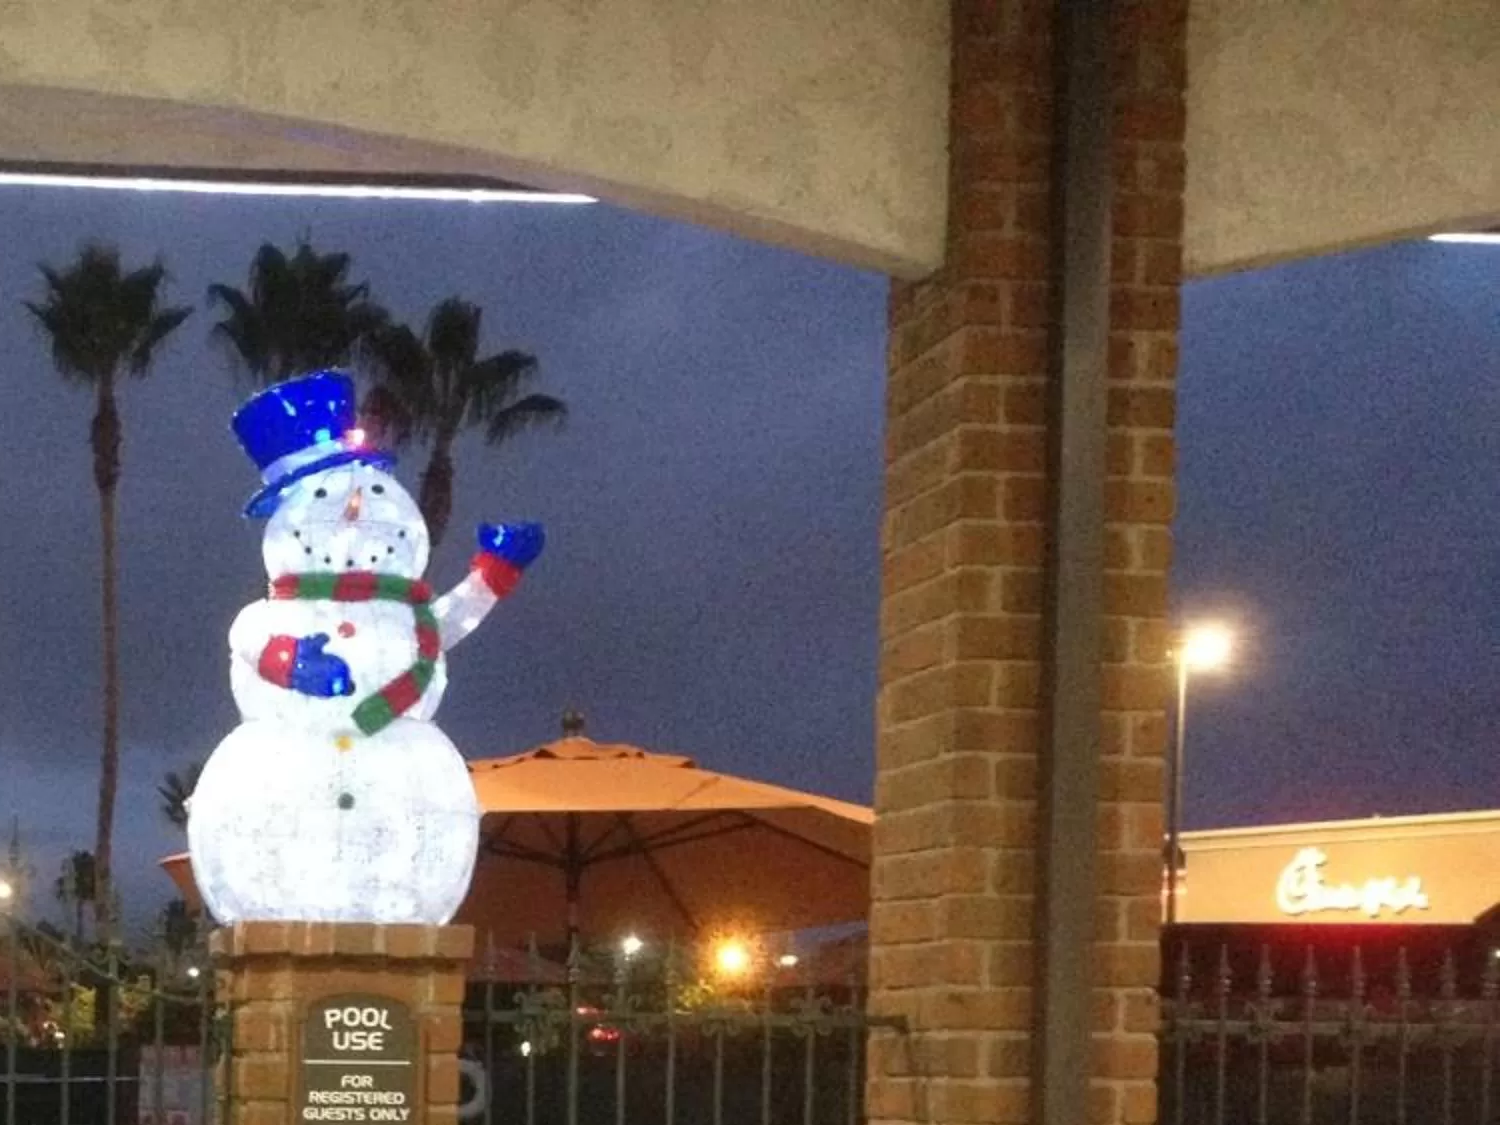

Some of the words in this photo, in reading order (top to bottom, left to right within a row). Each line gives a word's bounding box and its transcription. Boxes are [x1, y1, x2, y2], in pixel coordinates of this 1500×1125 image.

[324, 1006, 393, 1030] POOL
[332, 1030, 384, 1050] USE
[340, 1074, 374, 1088] FOR
[308, 1090, 405, 1104] REGISTERED
[302, 1106, 366, 1120] GUESTS
[369, 1107, 410, 1120] ONLY
